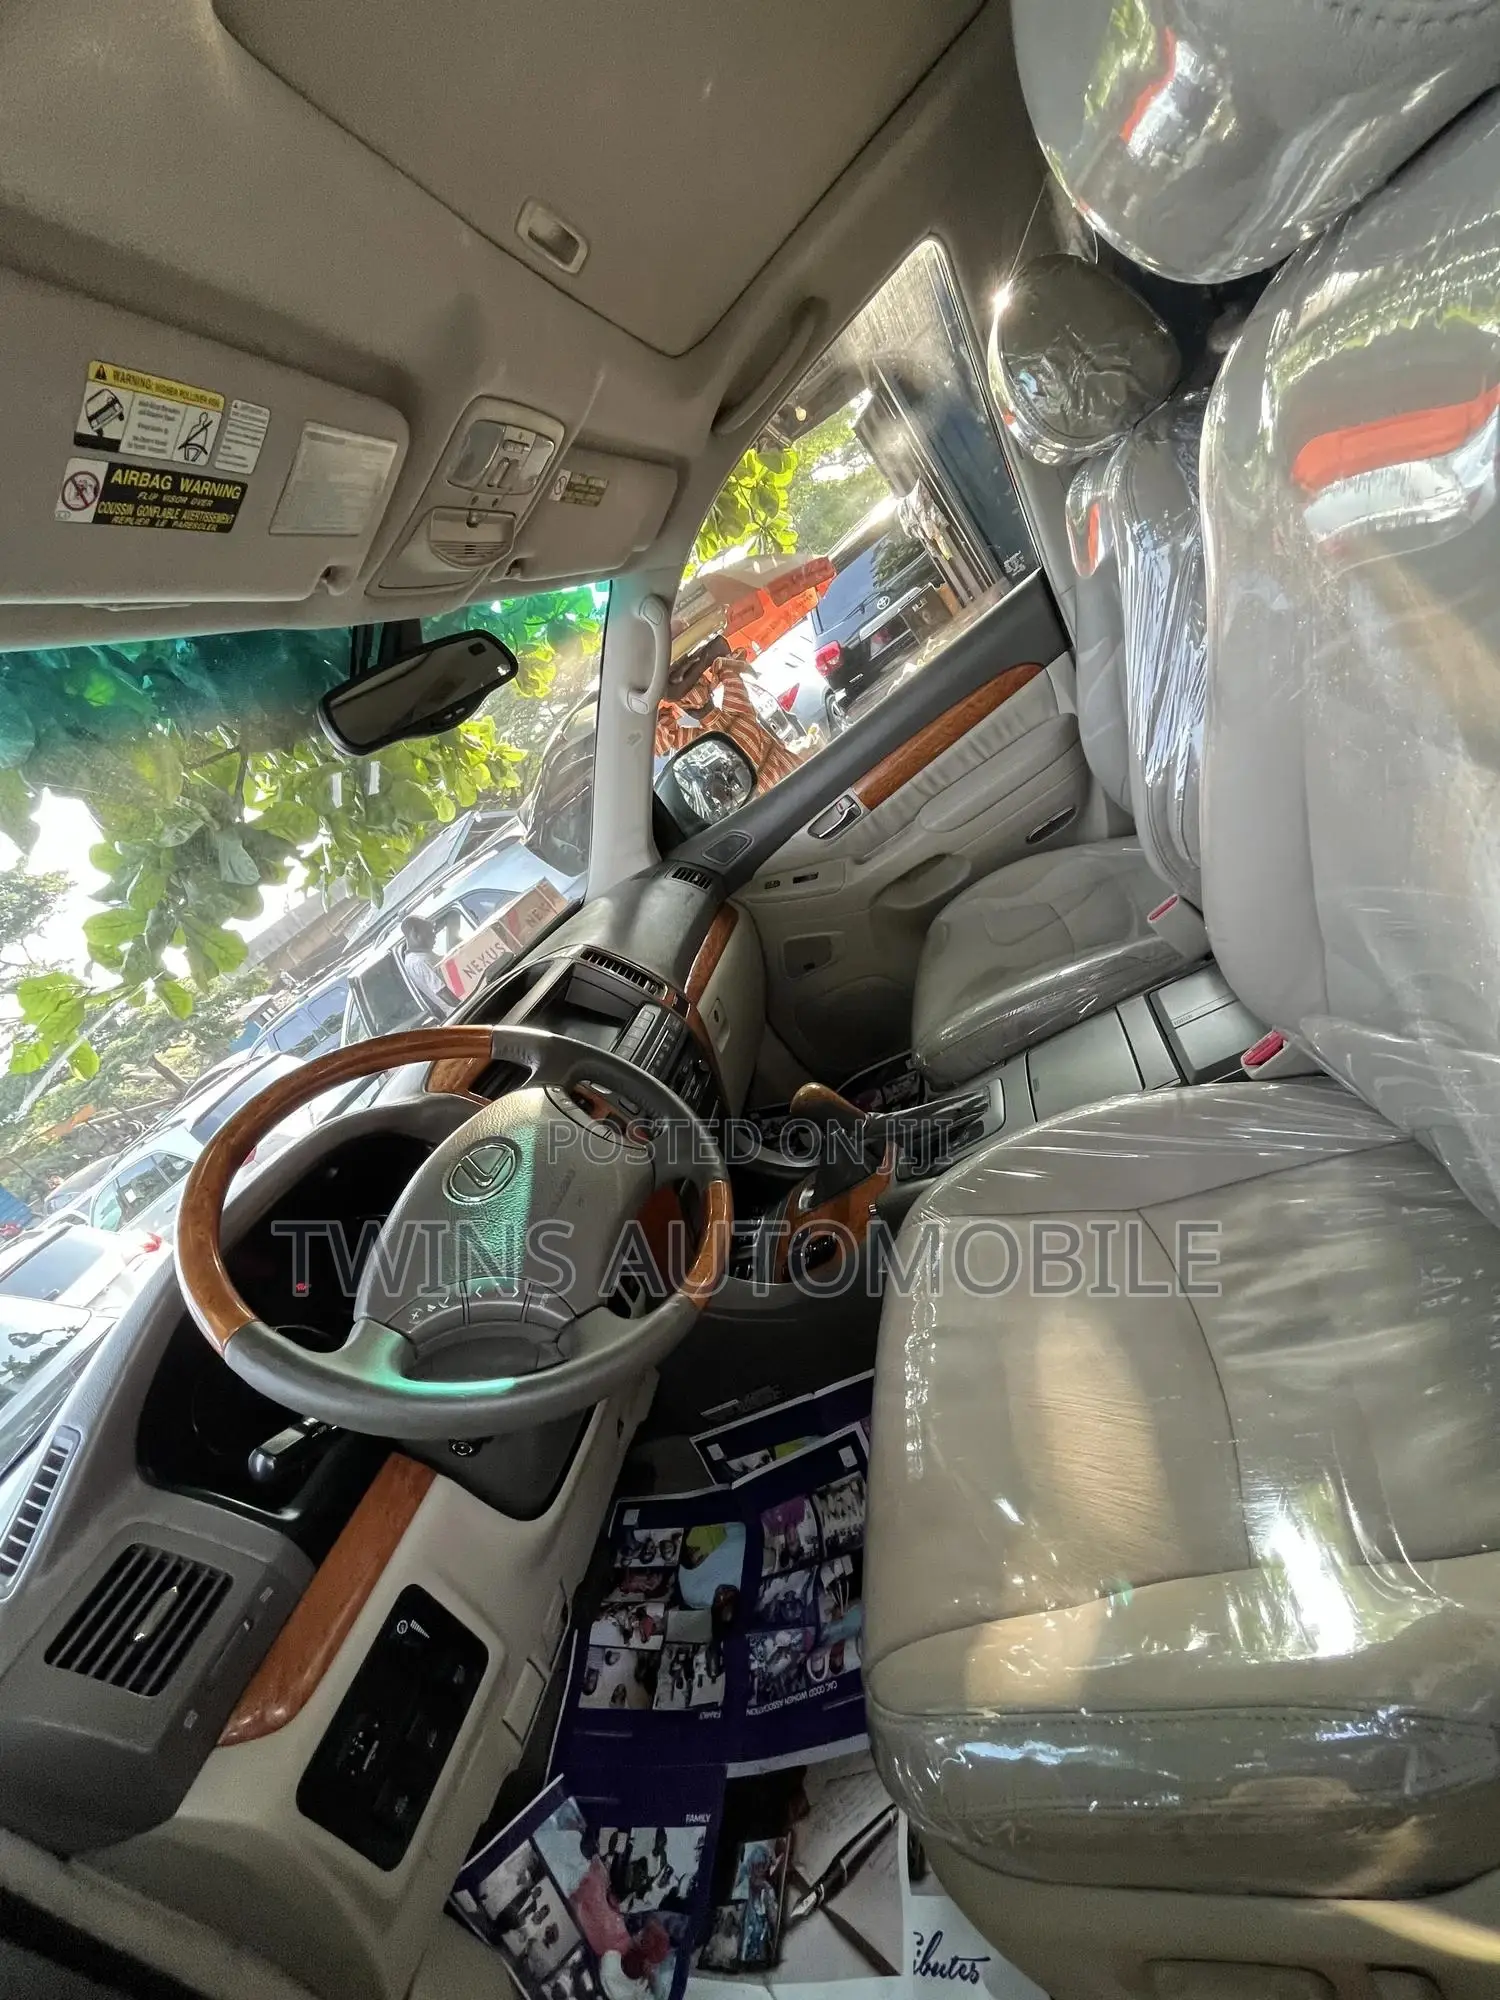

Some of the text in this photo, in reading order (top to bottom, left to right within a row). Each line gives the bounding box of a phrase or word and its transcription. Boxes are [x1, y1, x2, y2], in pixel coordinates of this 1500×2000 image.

[111, 468, 242, 500] AIRBAG WARNING
[137, 491, 214, 507] FLIP VISOR OVER
[98, 501, 236, 526] COUSSIN GONFLABLE AVERTISSEMENT
[111, 516, 151, 528] REPLIER
[155, 518, 166, 528] LE
[463, 942, 506, 979] NEXUS
[746, 1699, 784, 1717] ASSOCIATION
[685, 1813, 711, 1824] FAMILY
[912, 1930, 991, 1984] ibutes
